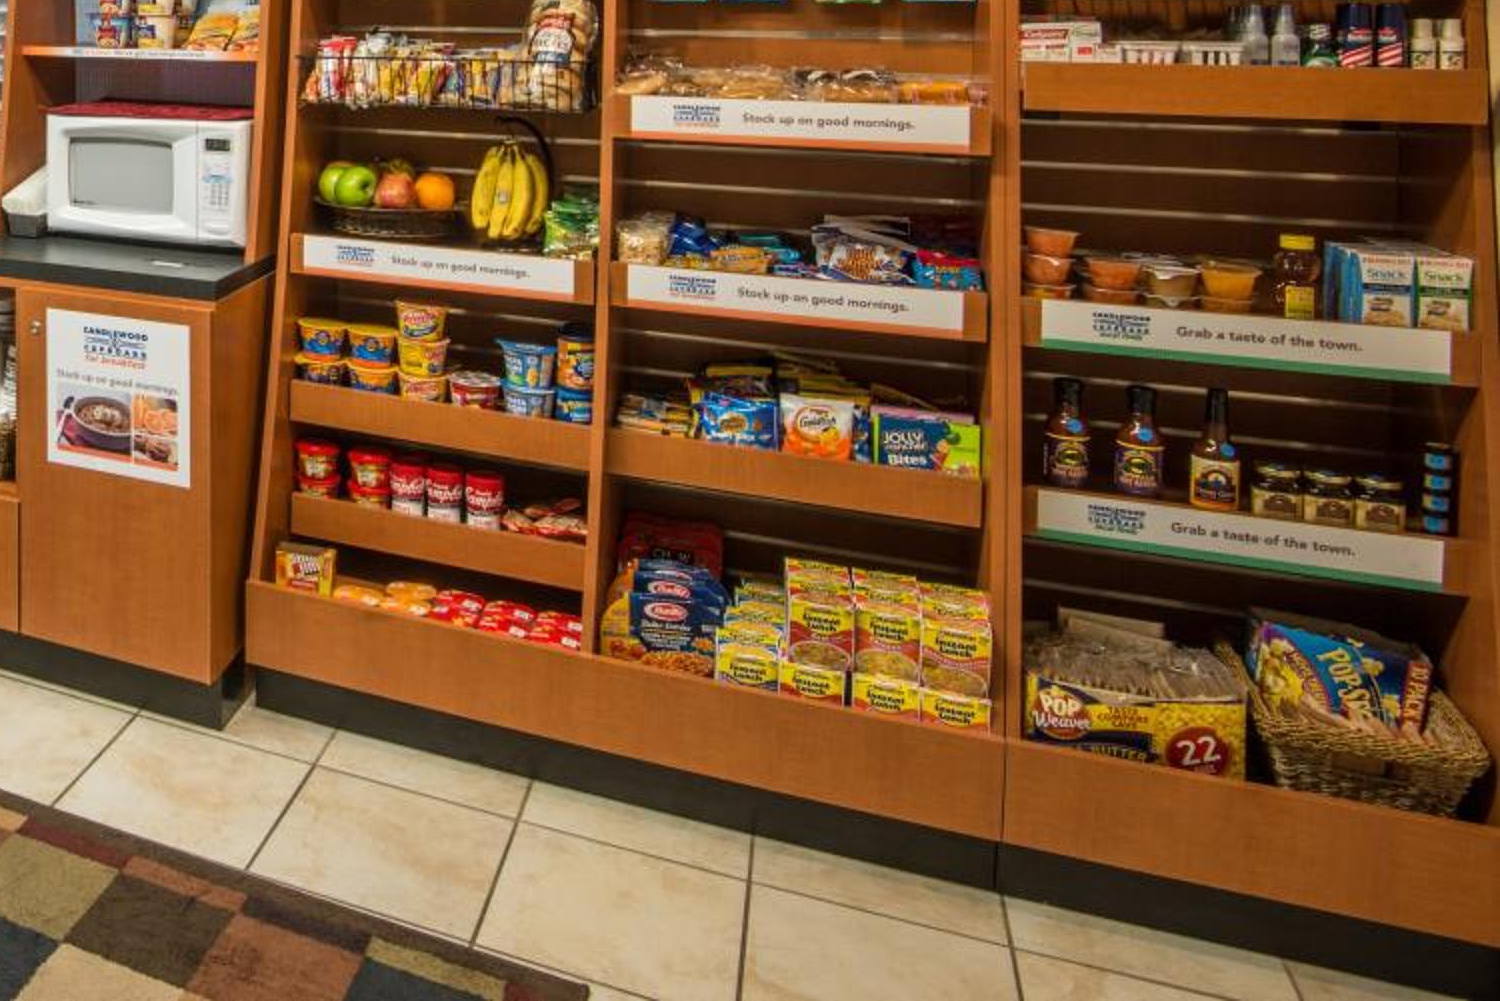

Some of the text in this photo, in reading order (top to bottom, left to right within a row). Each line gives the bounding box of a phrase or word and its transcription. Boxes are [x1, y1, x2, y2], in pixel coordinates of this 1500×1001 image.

[743, 112, 915, 132] Stock up on good mornings.
[451, 262, 477, 274] good
[737, 287, 909, 313] Stock up on good mornings.
[83, 326, 149, 342] CANDLEWOOD
[1176, 326, 1362, 352] Grab a taste of the town.
[883, 430, 923, 445] JOLLY
[1171, 521, 1356, 556] Grab a taste of the town.
[1039, 690, 1080, 717] POP
[1032, 710, 1092, 730] Weaver
[1176, 735, 1222, 766] 22
